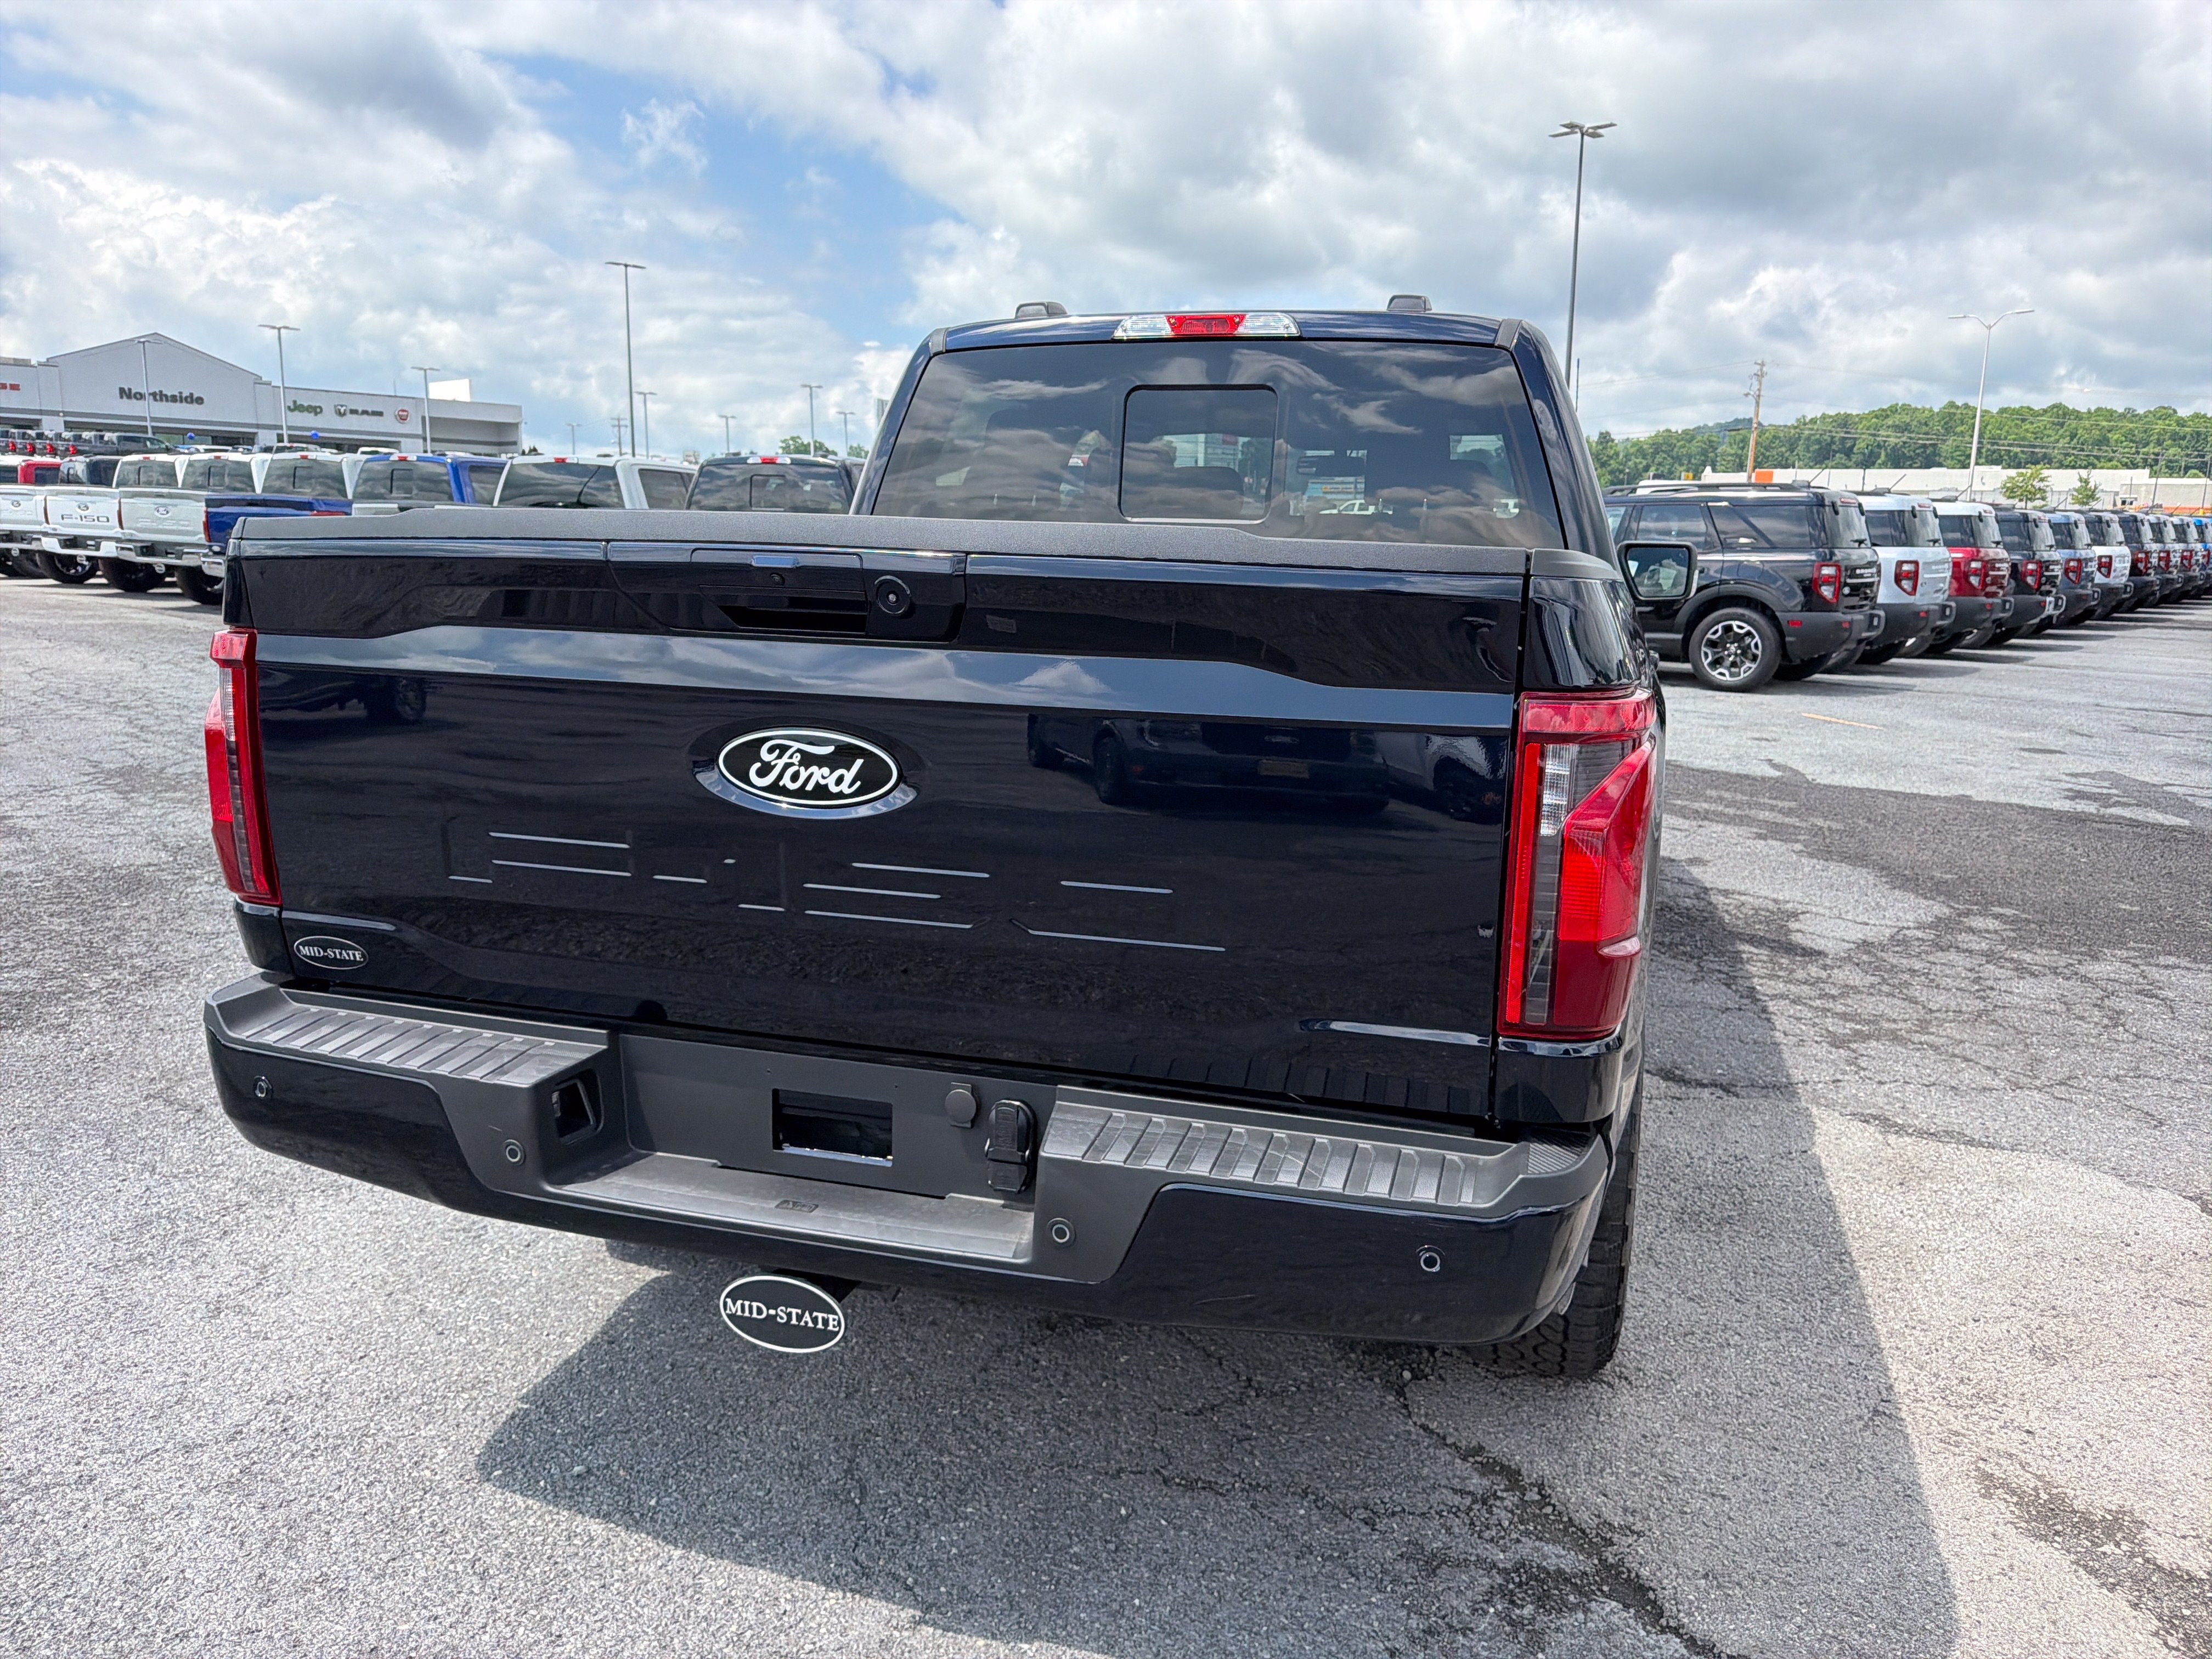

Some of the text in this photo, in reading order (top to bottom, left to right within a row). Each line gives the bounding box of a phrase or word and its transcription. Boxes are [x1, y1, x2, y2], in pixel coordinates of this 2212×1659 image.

[119, 386, 205, 405] Northside
[287, 400, 323, 416] Jeep
[749, 739, 864, 794] Ford
[298, 945, 364, 961] MID-STATE
[725, 1297, 840, 1332] MID-STATE
